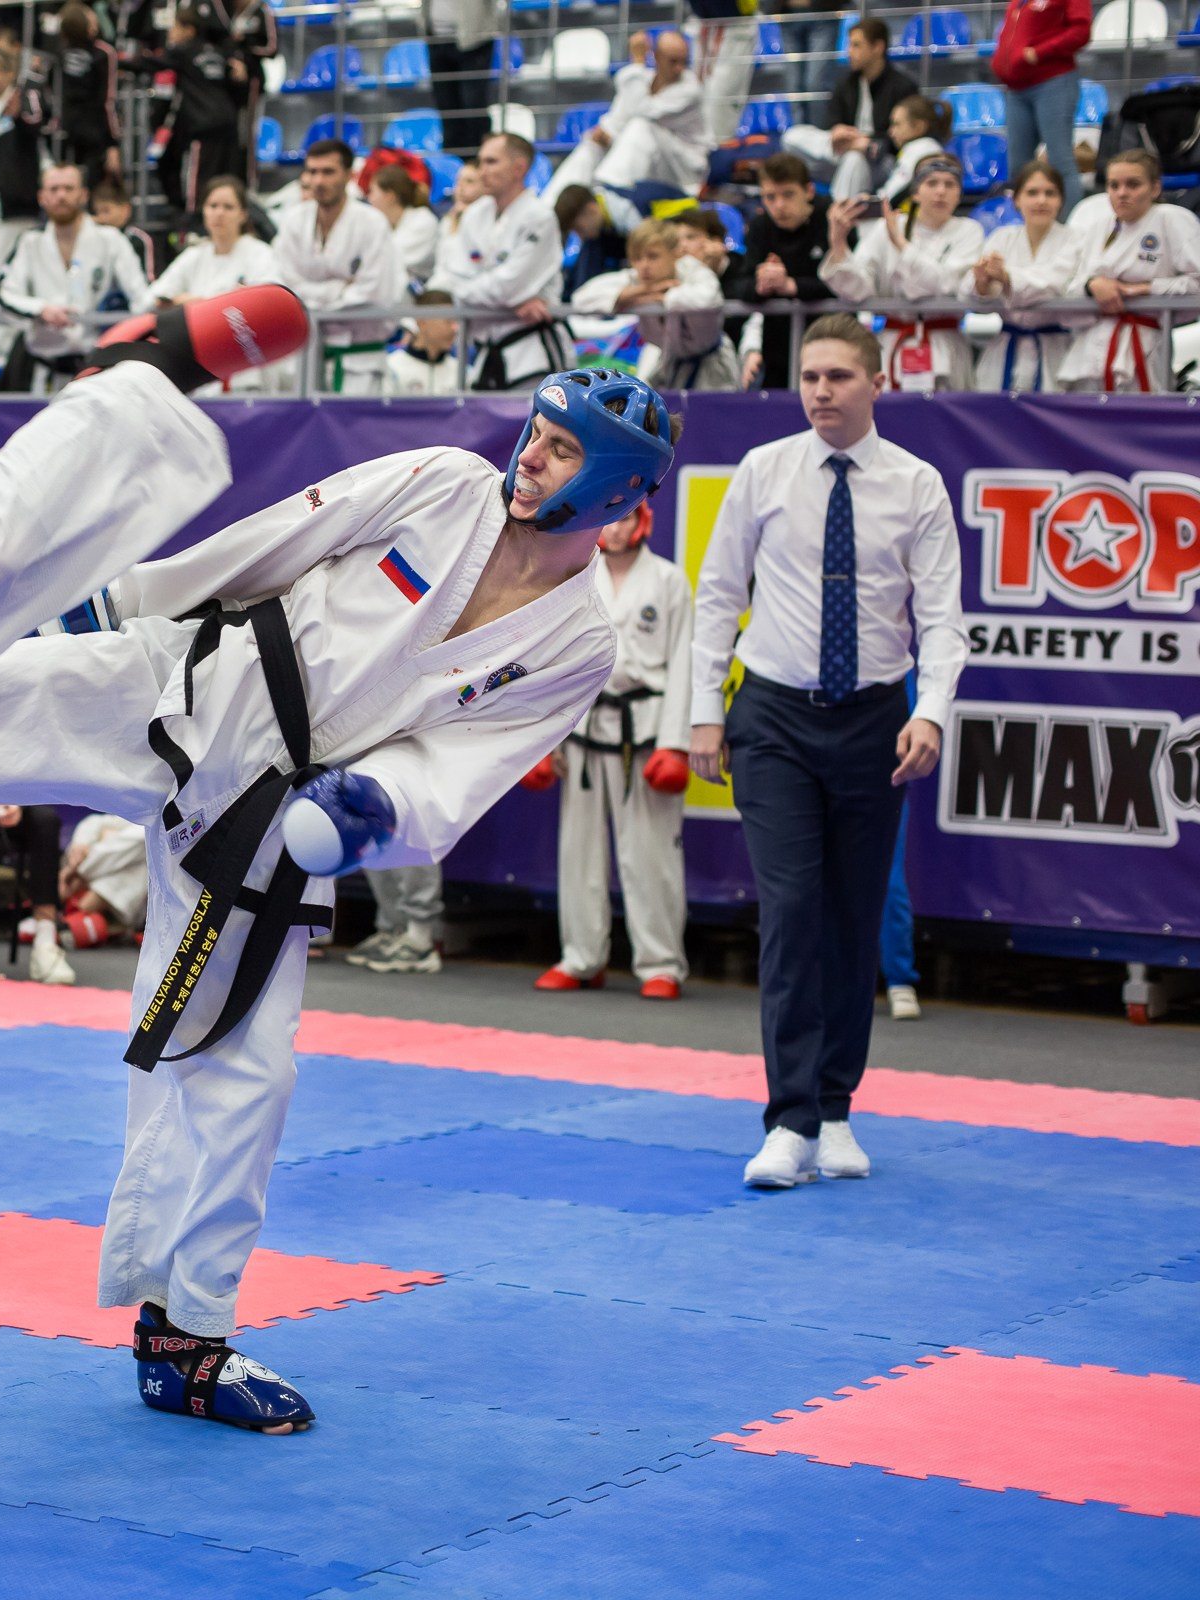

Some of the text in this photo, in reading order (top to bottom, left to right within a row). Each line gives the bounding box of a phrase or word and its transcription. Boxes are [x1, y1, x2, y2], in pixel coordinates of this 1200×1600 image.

[976, 480, 1200, 599] TOP
[968, 624, 1180, 664] SAFETY IS
[952, 715, 1167, 834] MAX
[140, 888, 214, 1032] EMELYANOV YAROSLAV
